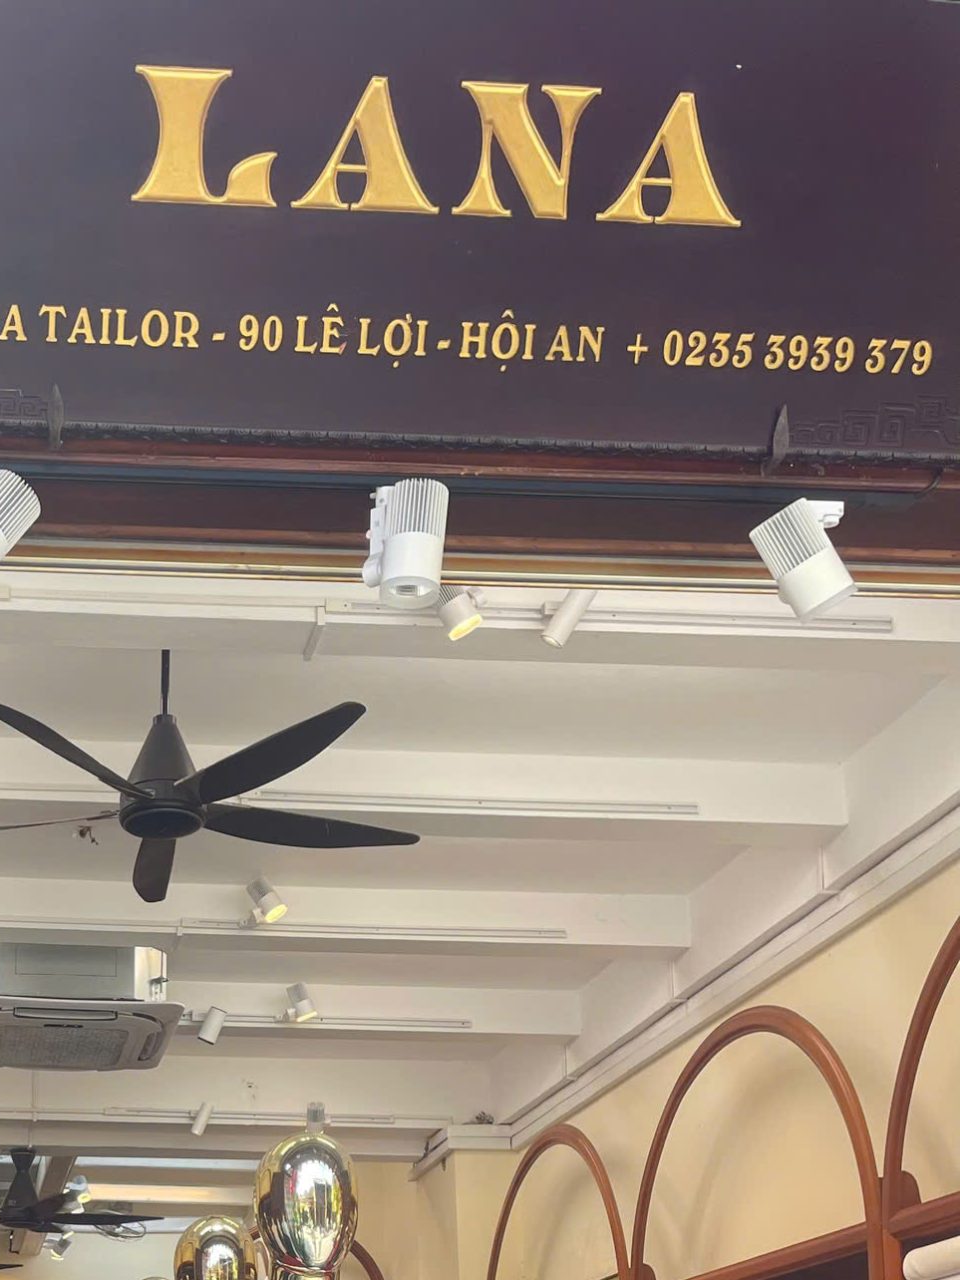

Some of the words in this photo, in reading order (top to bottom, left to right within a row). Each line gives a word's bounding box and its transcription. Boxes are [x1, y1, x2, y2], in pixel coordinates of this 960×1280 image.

[130, 63, 743, 229] LANA
[38, 303, 201, 350] TAILOR
[238, 313, 284, 353] 90
[294, 303, 347, 355] LÊ
[356, 313, 430, 369] LỢI
[458, 309, 537, 373] HỘI
[545, 324, 606, 363] AN
[662, 329, 757, 369] 0235
[763, 333, 857, 374] 3939
[864, 337, 935, 377] 379
